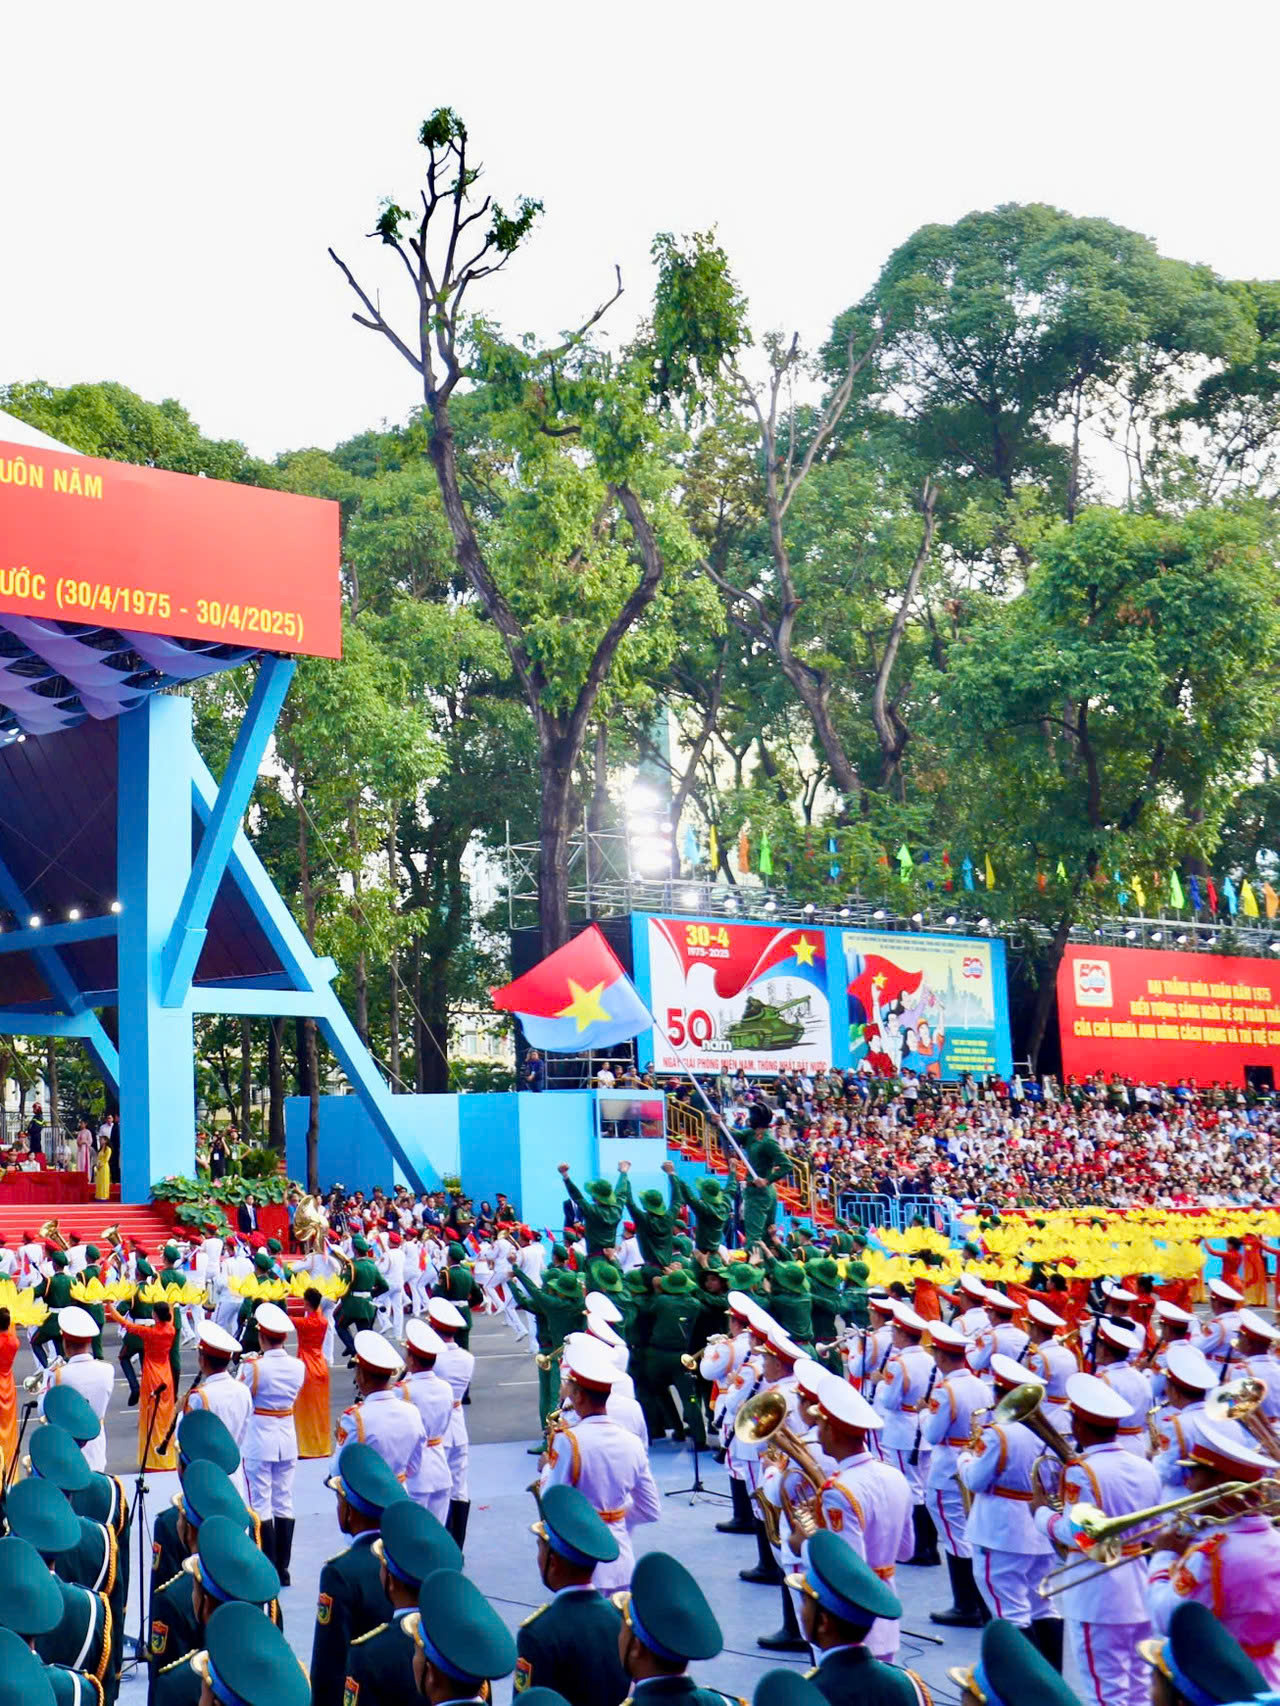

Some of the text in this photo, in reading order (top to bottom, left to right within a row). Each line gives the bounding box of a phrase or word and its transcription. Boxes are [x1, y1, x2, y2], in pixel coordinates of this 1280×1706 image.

[52, 465, 104, 500] NĂM
[55, 576, 172, 620] (30/4/1975
[196, 602, 304, 644] 30/4/2025)
[686, 924, 729, 948] 30-4
[667, 1008, 716, 1050] 50
